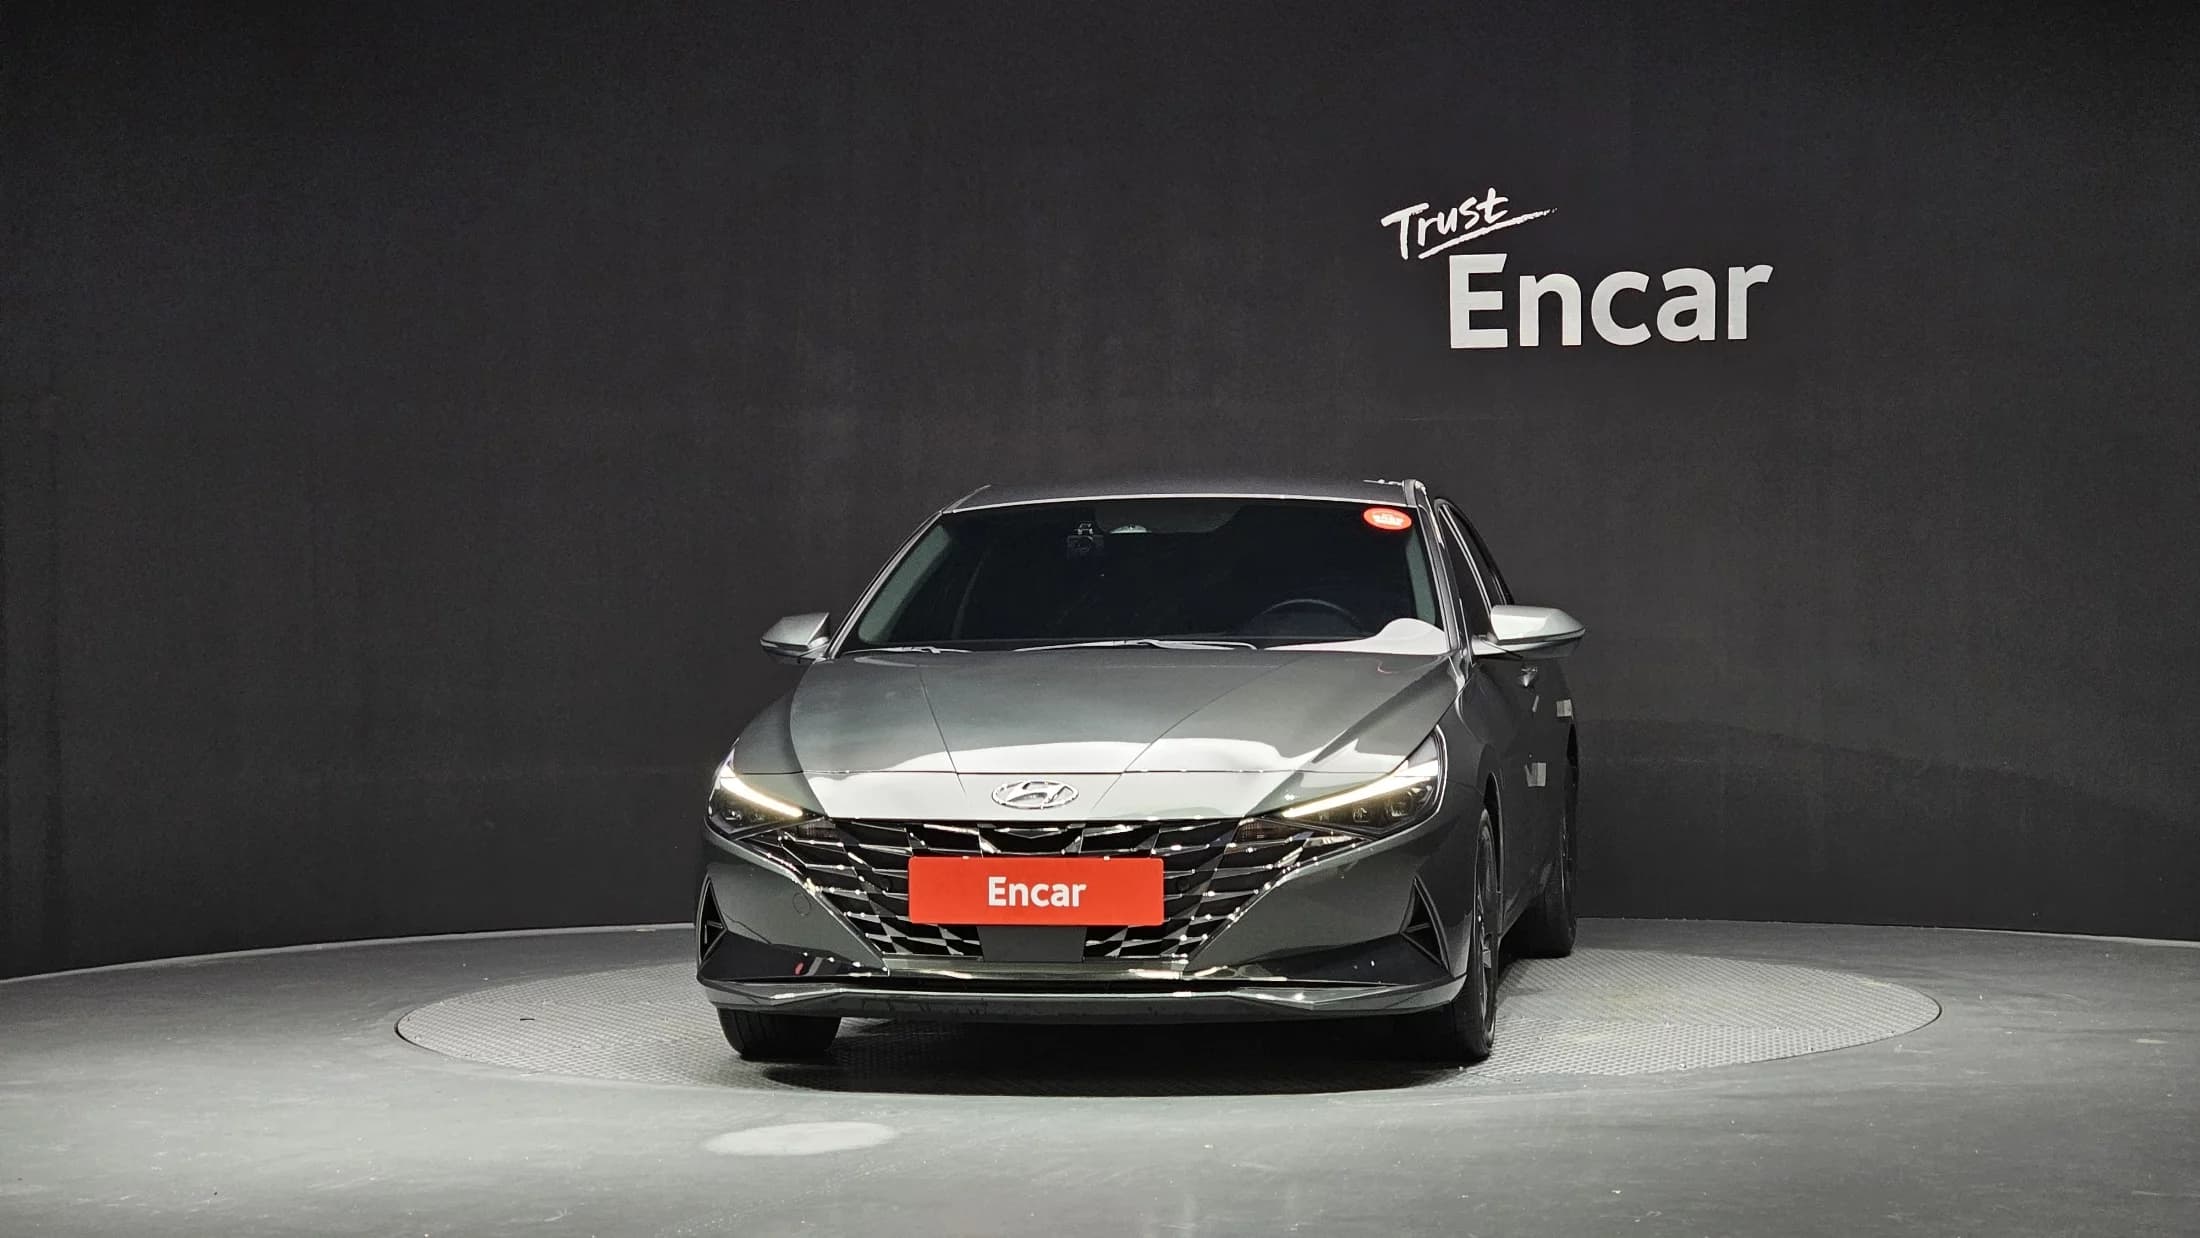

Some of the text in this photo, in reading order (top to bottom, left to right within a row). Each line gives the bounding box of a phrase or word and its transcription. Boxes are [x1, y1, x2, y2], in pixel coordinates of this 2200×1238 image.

[1381, 187, 1509, 260] Trust
[1448, 253, 1774, 349] Encar
[988, 876, 1087, 907] Encar
